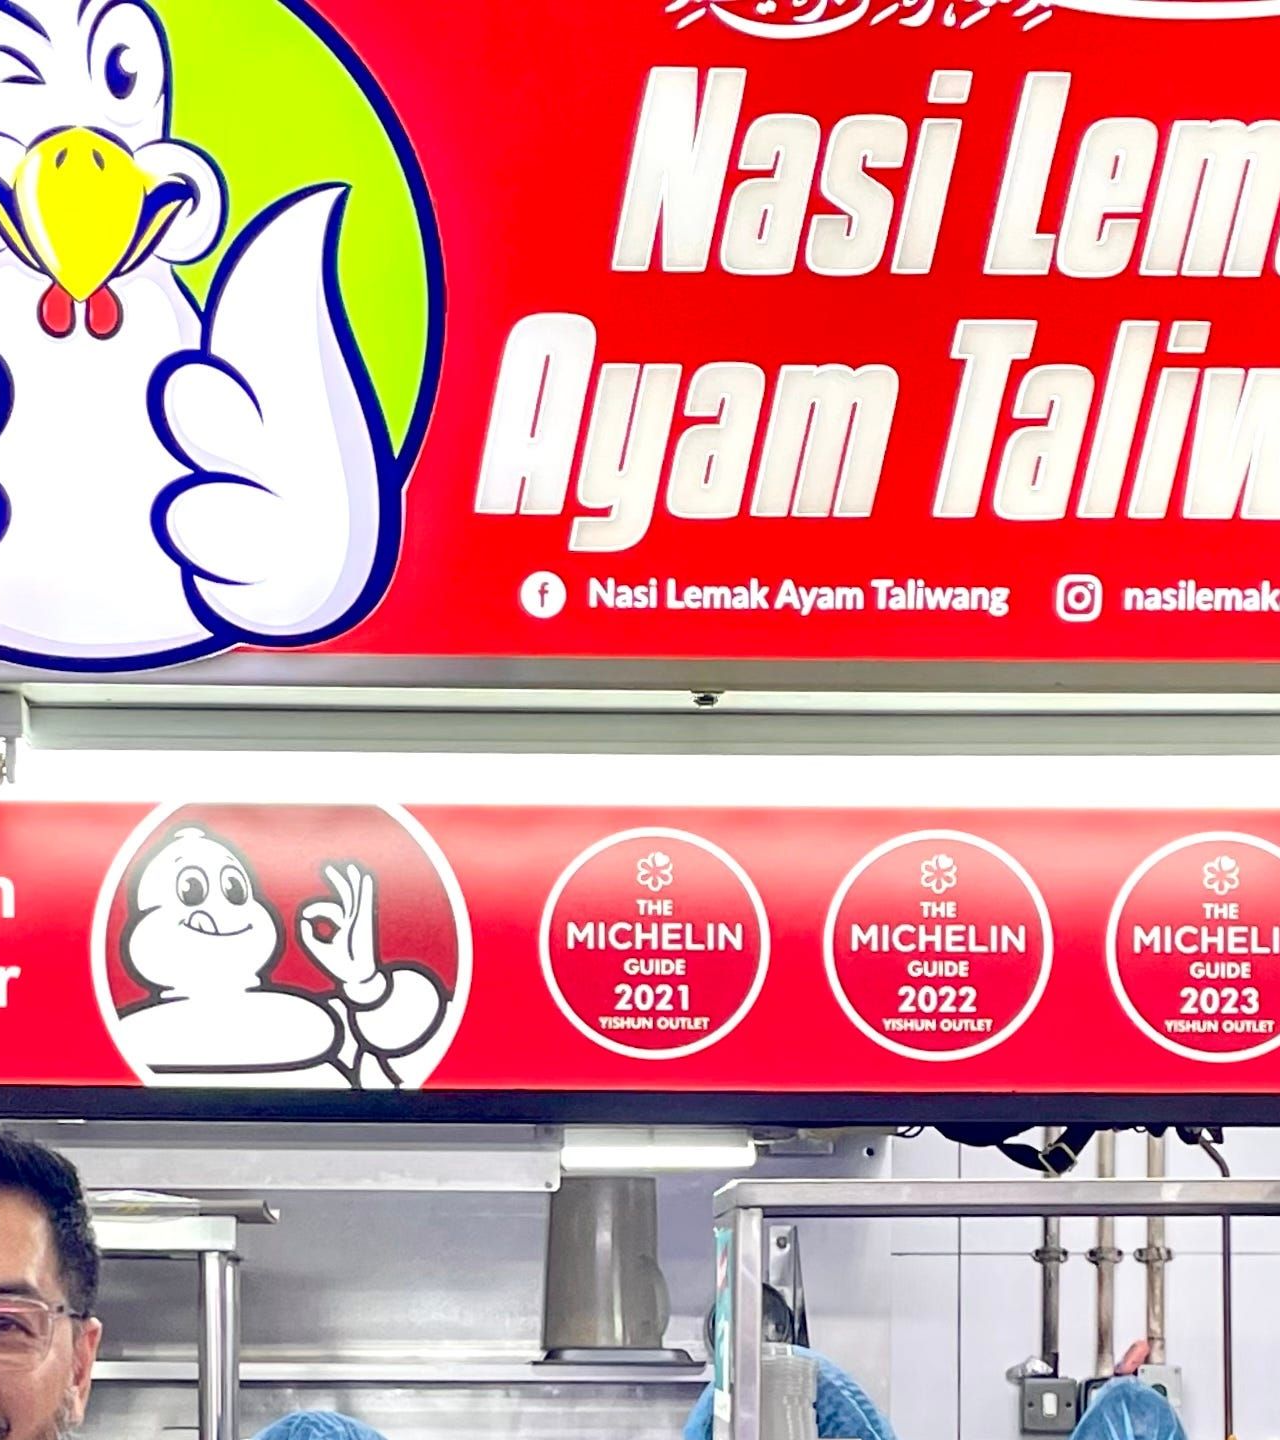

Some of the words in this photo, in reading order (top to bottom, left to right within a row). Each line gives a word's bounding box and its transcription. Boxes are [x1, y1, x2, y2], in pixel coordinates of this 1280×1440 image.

[610, 65, 974, 278] Nasi
[473, 312, 900, 553] Ayam
[588, 577, 658, 609] Nasi
[666, 578, 769, 611] Lemak
[775, 579, 865, 616] Ayam
[871, 578, 1011, 617] Taliwang
[636, 898, 673, 917] THE
[920, 901, 957, 919] THE
[1202, 903, 1239, 921] THE
[566, 922, 743, 952] MICHELIN
[850, 924, 1027, 954] MICHELIN
[624, 957, 686, 977] GUIDE
[907, 960, 970, 979] GUIDE
[1188, 961, 1252, 981] GUIDE
[614, 983, 690, 1012] 2021
[898, 985, 978, 1014] 2022
[1179, 986, 1261, 1015] 2023
[598, 1016, 654, 1031] YISHUN
[656, 1016, 710, 1031] OUTLET
[882, 1018, 937, 1033] YISHUN
[940, 1018, 993, 1033] OUTLET
[1164, 1020, 1219, 1034] YISHUN
[1222, 1020, 1275, 1034] OUTLET
